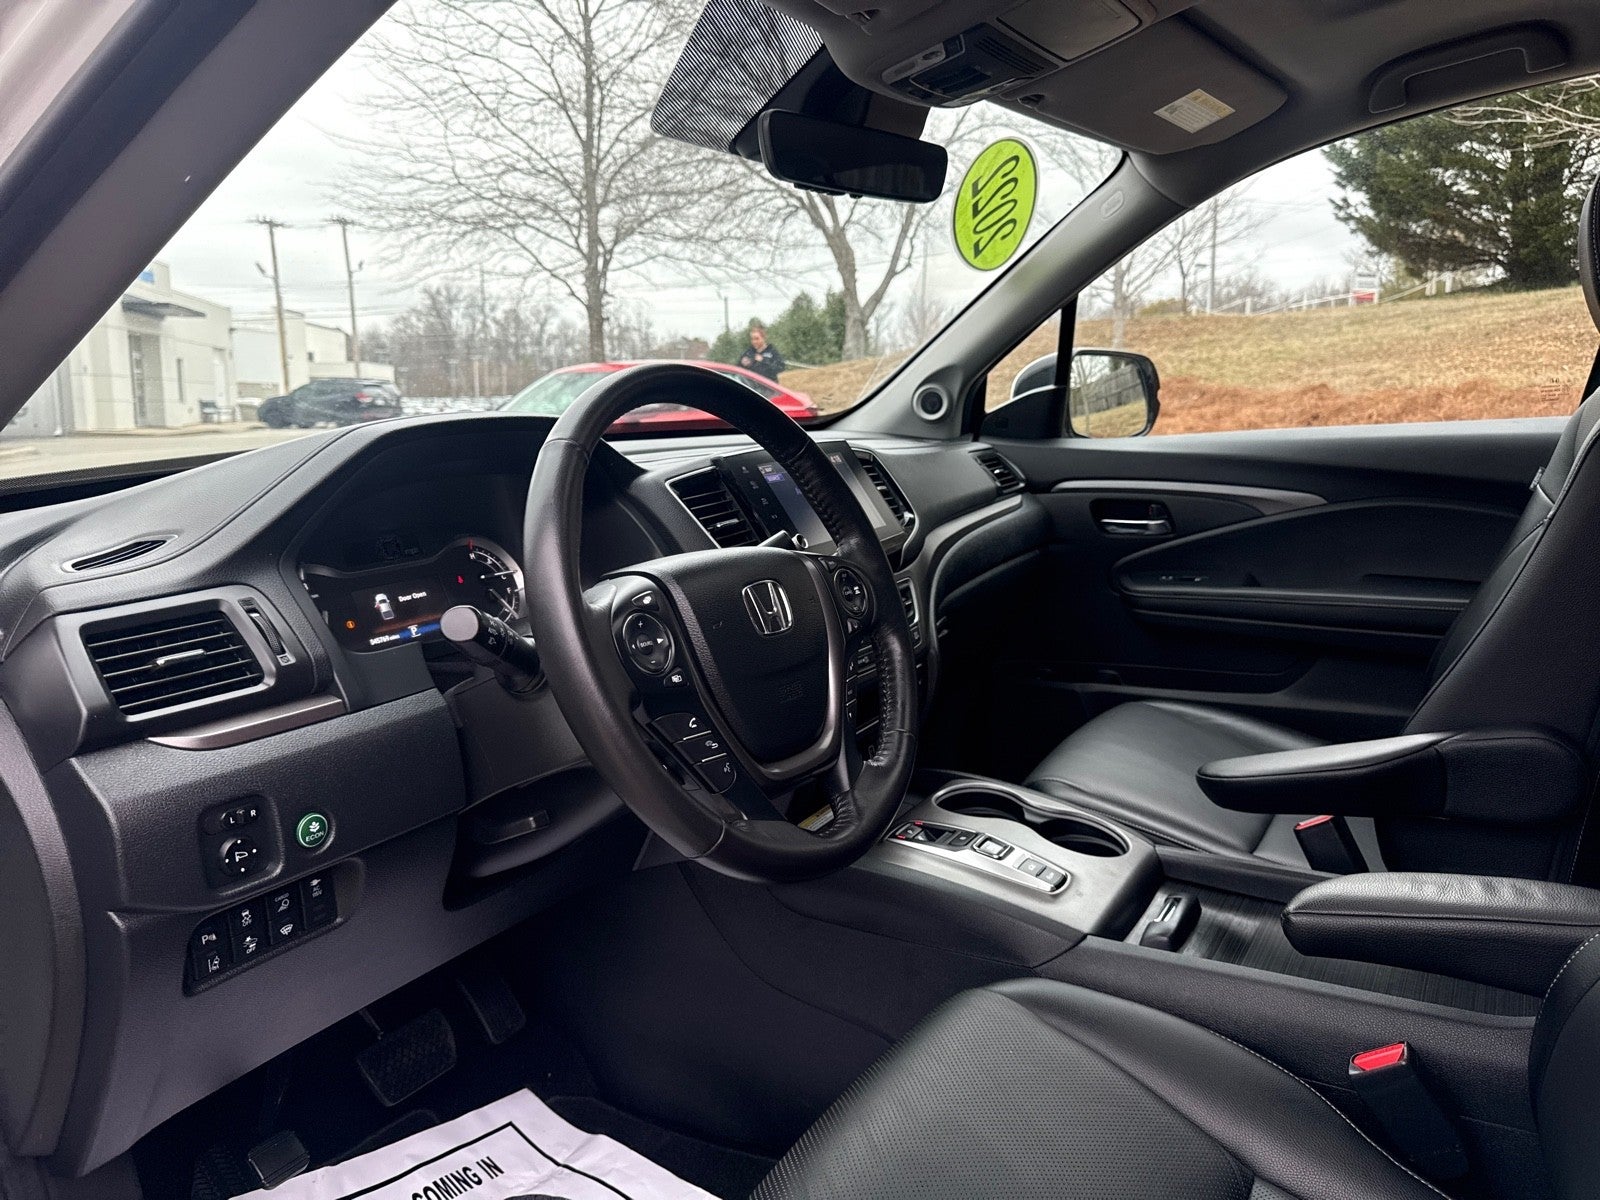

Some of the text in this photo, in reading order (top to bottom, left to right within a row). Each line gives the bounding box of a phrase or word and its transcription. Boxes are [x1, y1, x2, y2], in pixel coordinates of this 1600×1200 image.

[398, 591, 427, 603] Door Open
[250, 809, 257, 817] R
[305, 831, 324, 842] ECON
[475, 1156, 505, 1180] IN
